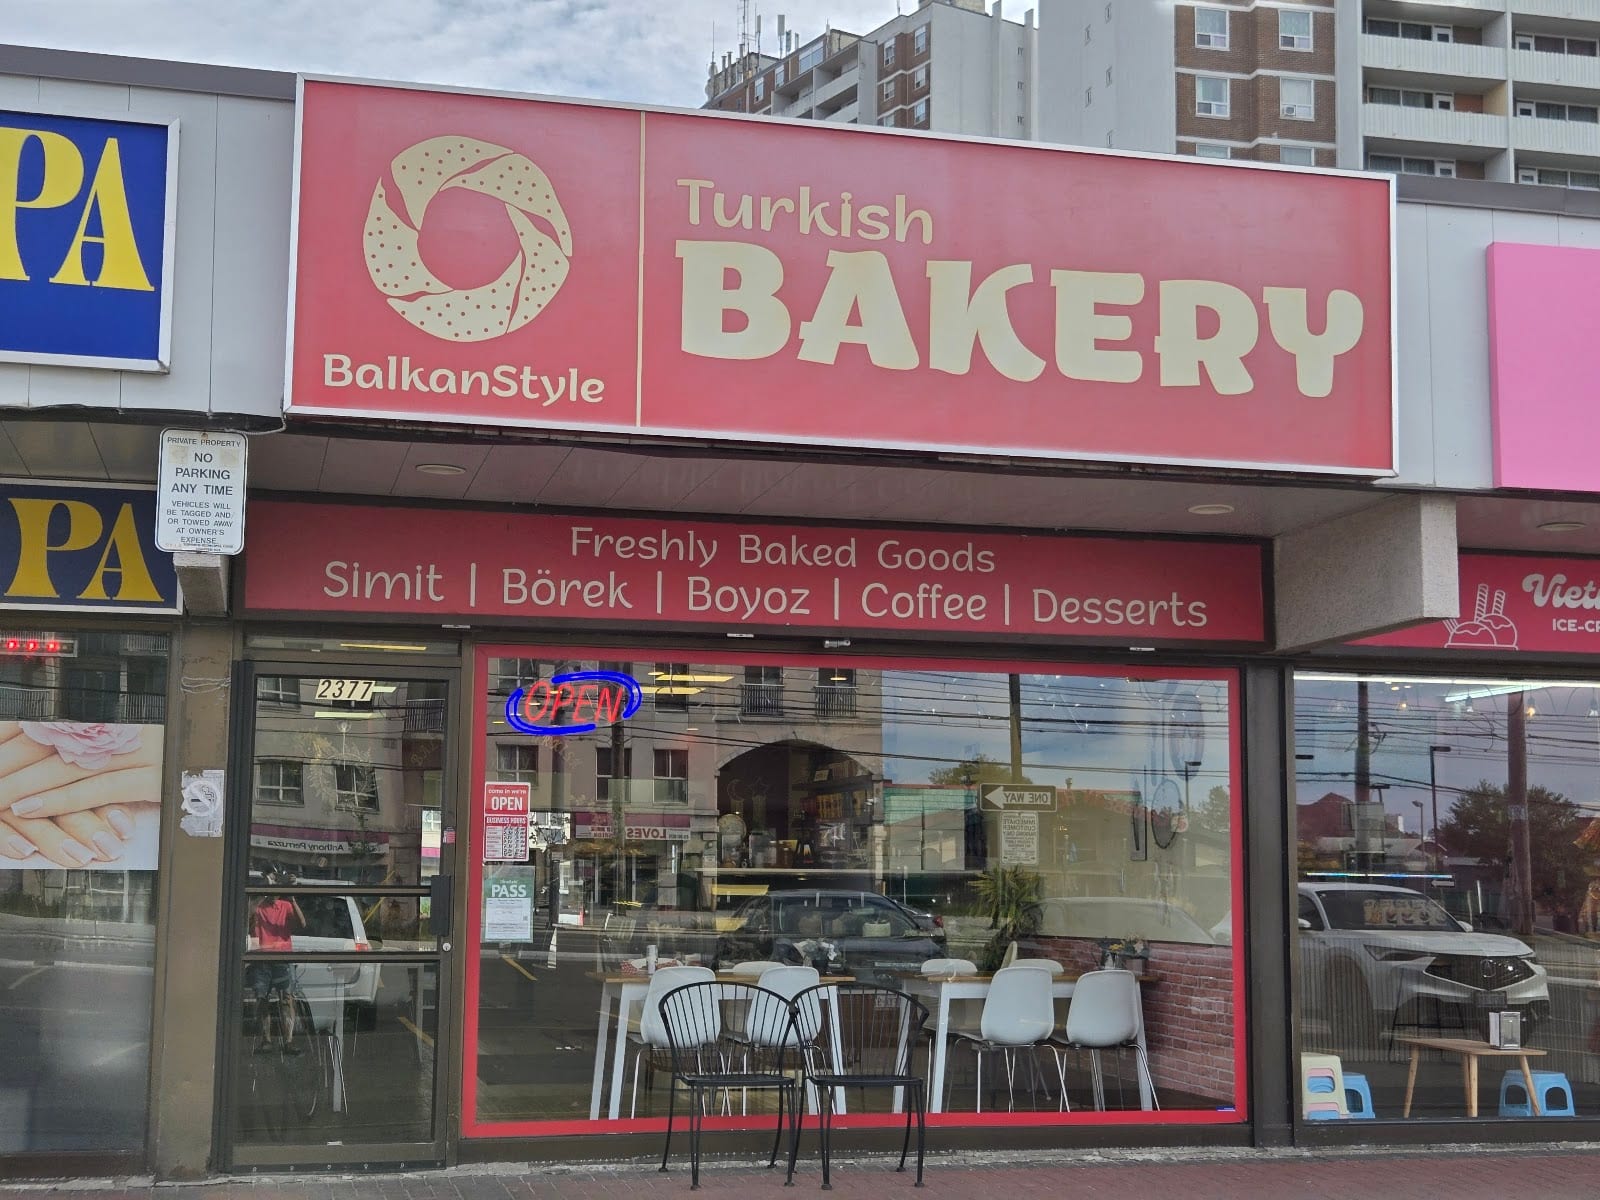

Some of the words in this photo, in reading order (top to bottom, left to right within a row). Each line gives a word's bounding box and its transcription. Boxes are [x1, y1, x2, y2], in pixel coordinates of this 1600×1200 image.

[0, 126, 155, 291] PA
[676, 178, 934, 245] Turkish
[675, 239, 1364, 398] BAKERY
[323, 353, 605, 407] BalkanStyle
[167, 437, 198, 445] PRIVATE
[200, 439, 241, 447] PROPERTY
[194, 452, 213, 463] NO
[175, 467, 231, 480] PARKING
[171, 483, 197, 494] ANY
[203, 484, 233, 496] TIME
[172, 500, 210, 509] VEHICLES
[213, 502, 231, 510] WILL
[181, 509, 212, 518] TAGGED
[182, 518, 210, 526] TOWED
[213, 520, 233, 528] AWAY
[180, 536, 217, 544] EXPENSE
[4, 497, 165, 602] PA
[570, 526, 718, 568] Freshly
[738, 533, 857, 568] Baked
[876, 539, 996, 573] Goods
[323, 560, 445, 602] Simit
[502, 567, 633, 609] Börek
[686, 576, 811, 621] Boyoz
[860, 582, 988, 621] Coffee
[1032, 588, 1209, 628] Desserts
[1522, 573, 1600, 610] Viet
[317, 679, 374, 700] 2377
[524, 679, 624, 723] OPEN
[491, 796, 523, 811] OPEN
[486, 816, 510, 824] BUSINESS
[491, 884, 527, 898] PASS
